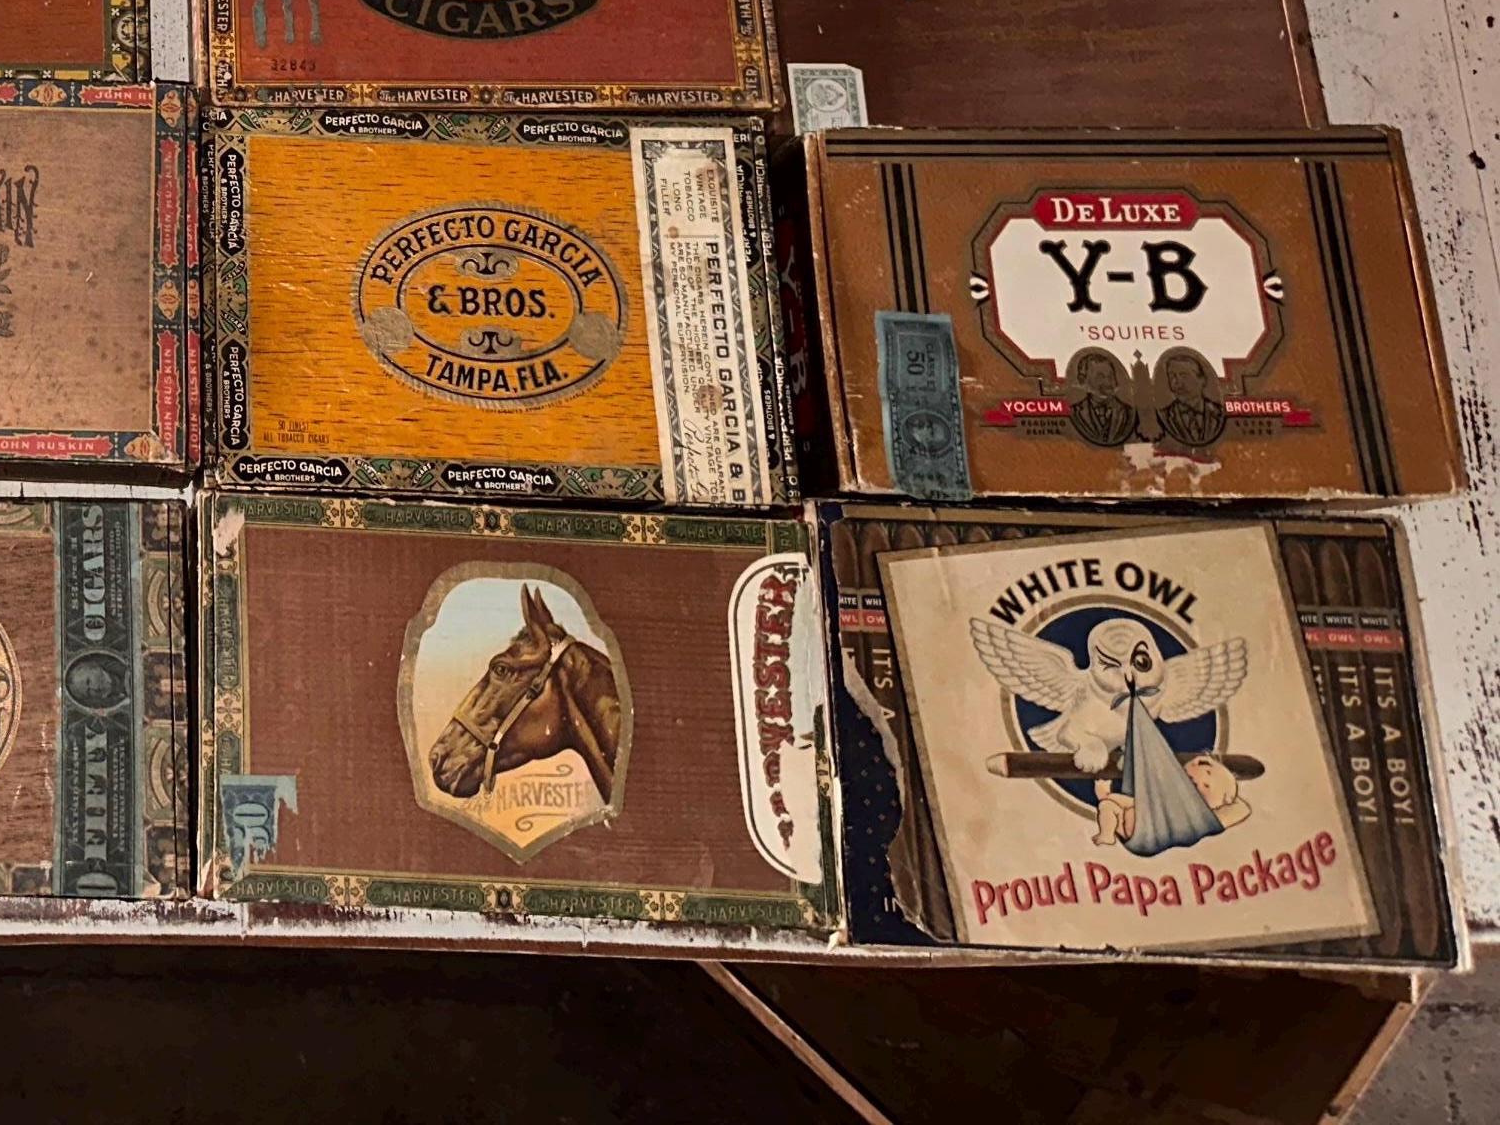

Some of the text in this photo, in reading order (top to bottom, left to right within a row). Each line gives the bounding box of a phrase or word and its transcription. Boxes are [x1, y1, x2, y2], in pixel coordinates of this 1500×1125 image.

[397, 88, 469, 103] HARVESTER
[521, 89, 595, 104] HARVESTER
[647, 90, 721, 105] HARVESTER
[325, 113, 423, 130] PERFECTO GARCIA
[357, 127, 398, 136] BROTHERS
[523, 121, 625, 139] PERFECTO GARCIA
[556, 135, 598, 144] BROTHERS
[226, 154, 242, 250] PERFECTO GARCIA
[659, 177, 673, 216] FILLER
[672, 181, 683, 213] LONG
[684, 170, 696, 223] TOBACCO
[696, 172, 709, 220] VINTAGE
[705, 168, 720, 225] EXQUISITE
[371, 215, 603, 288] PERFECTO GARCIA
[668, 241, 678, 256] MY
[670, 260, 682, 318] PERSONAL
[1038, 238, 1209, 314] Y-B
[458, 286, 556, 319] BROS.
[678, 266, 702, 414] SO MANUFACTURED UNDER
[692, 241, 721, 443] THE HEREIN CONTAINED ARE
[1079, 324, 1186, 343] 'SQUIRES
[687, 276, 717, 474] OF HIGHEST VINTAGE
[705, 241, 746, 504] PERFECTO GARCIA B
[229, 346, 246, 446] PERFECTO GARCIA
[1003, 400, 1064, 413] YOCUM
[239, 459, 343, 477] PERFECTO GARCIA
[989, 557, 1200, 625] WHITE OWL
[1325, 615, 1354, 625] WHITE
[1327, 632, 1357, 644] OWL
[1360, 616, 1390, 627] WHITE
[1362, 633, 1393, 645] OWL
[81, 504, 109, 862] FIFTY CIGARS
[872, 647, 894, 691] IT'S
[1336, 665, 1379, 825] IT'S A BOY!
[1371, 666, 1416, 825] IT'S A BOY!
[971, 828, 1338, 925] Proud Papa Package
